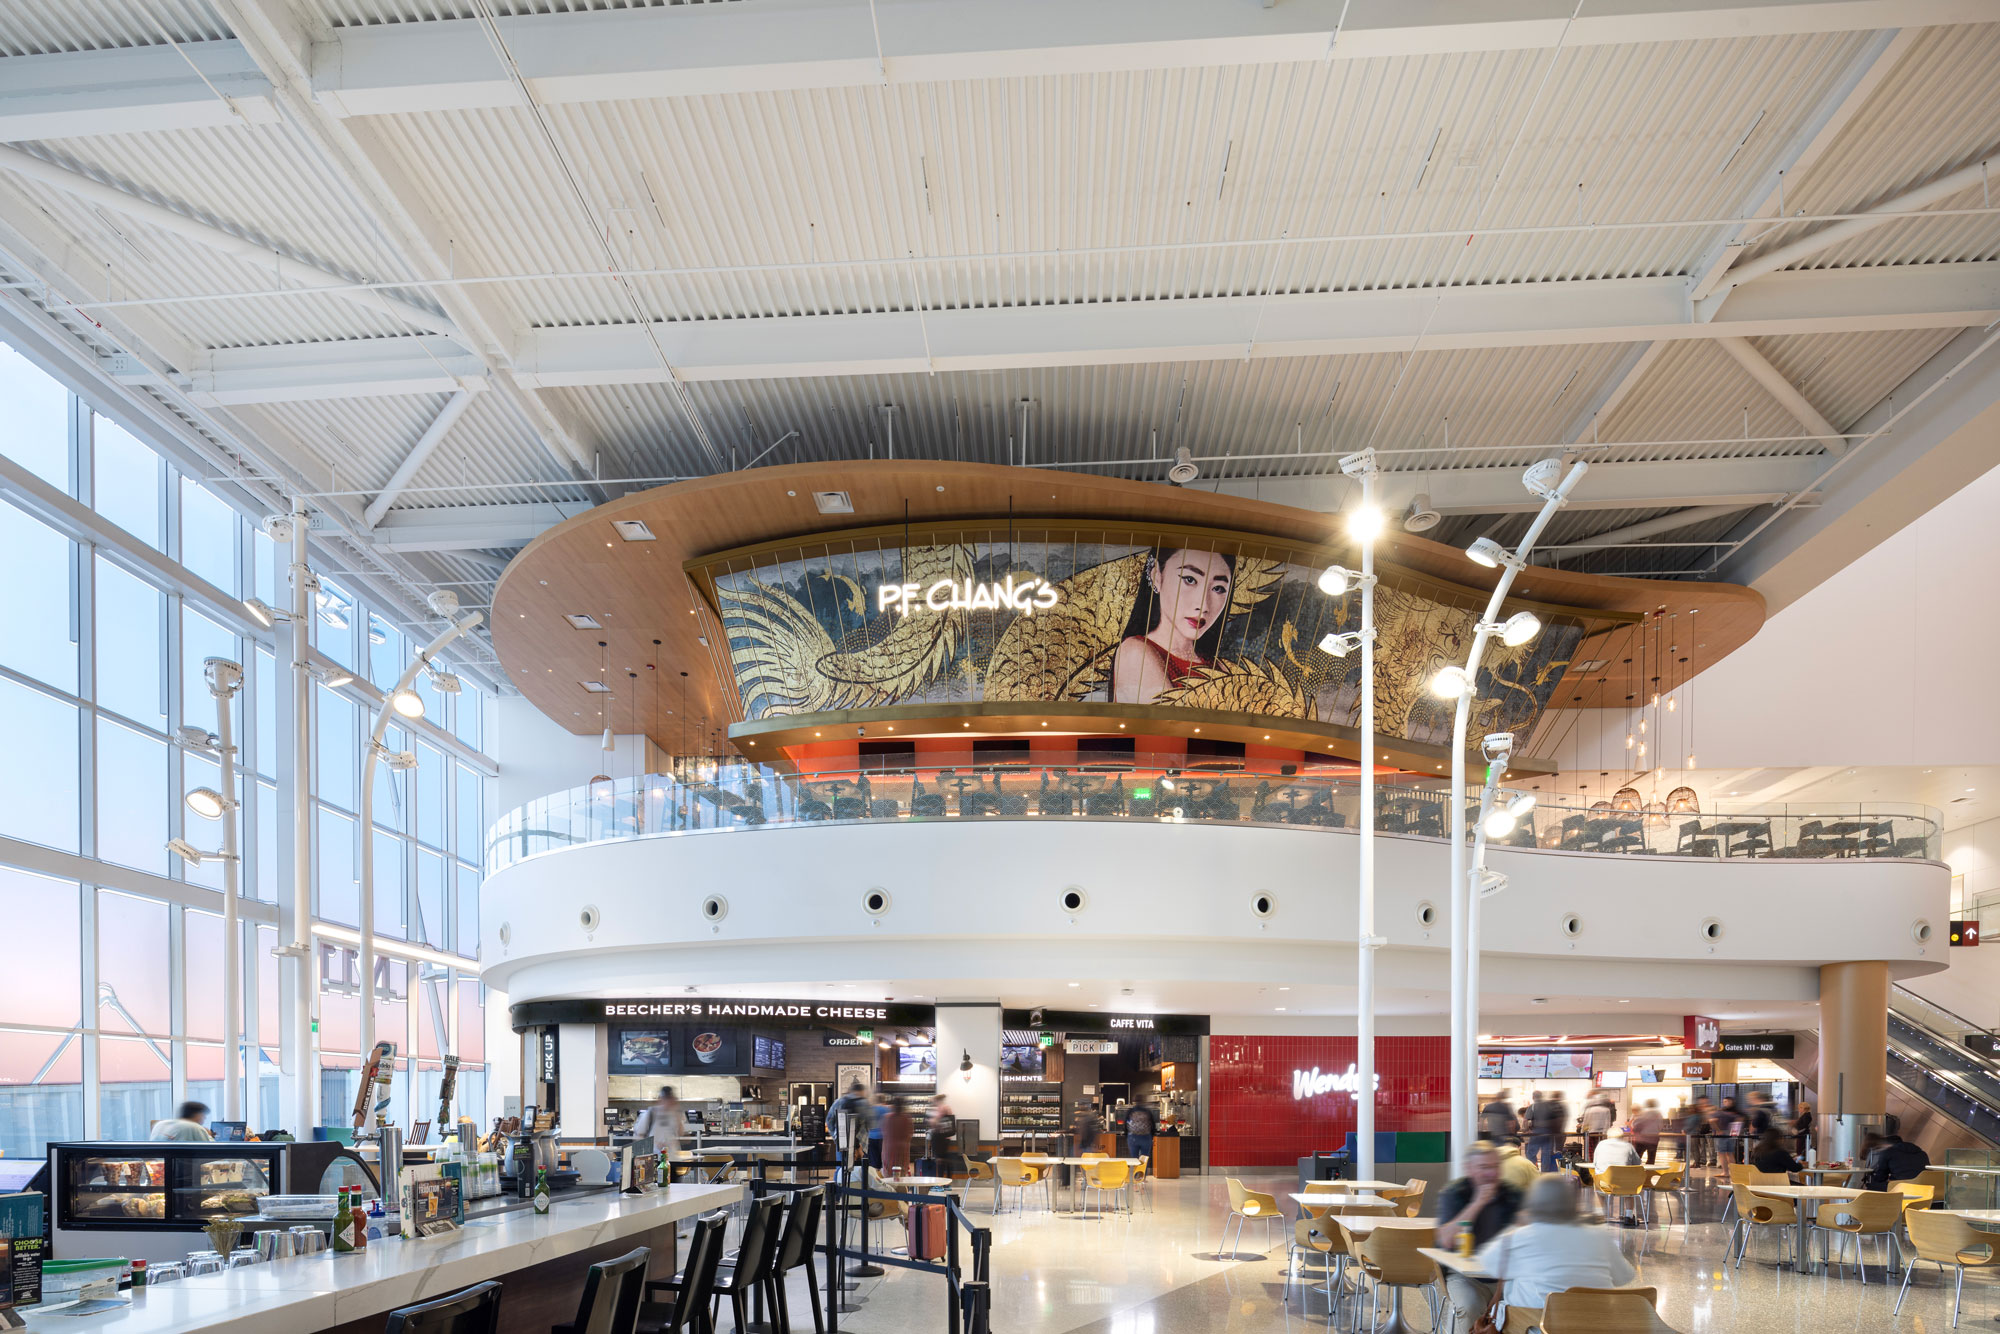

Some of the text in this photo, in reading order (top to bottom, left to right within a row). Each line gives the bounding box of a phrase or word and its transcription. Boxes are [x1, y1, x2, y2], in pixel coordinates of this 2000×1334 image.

[878, 575, 1058, 617] P.F. CHANG'S
[605, 1004, 887, 1019] BEECHER'S HANDMADE CHEESE
[1110, 1019, 1154, 1029] CAFFE VITA
[829, 1038, 863, 1046] ORDER
[1072, 1043, 1113, 1052] PICK UP
[545, 1034, 554, 1080] PICK UP
[14, 1238, 43, 1246] CHOOSE
